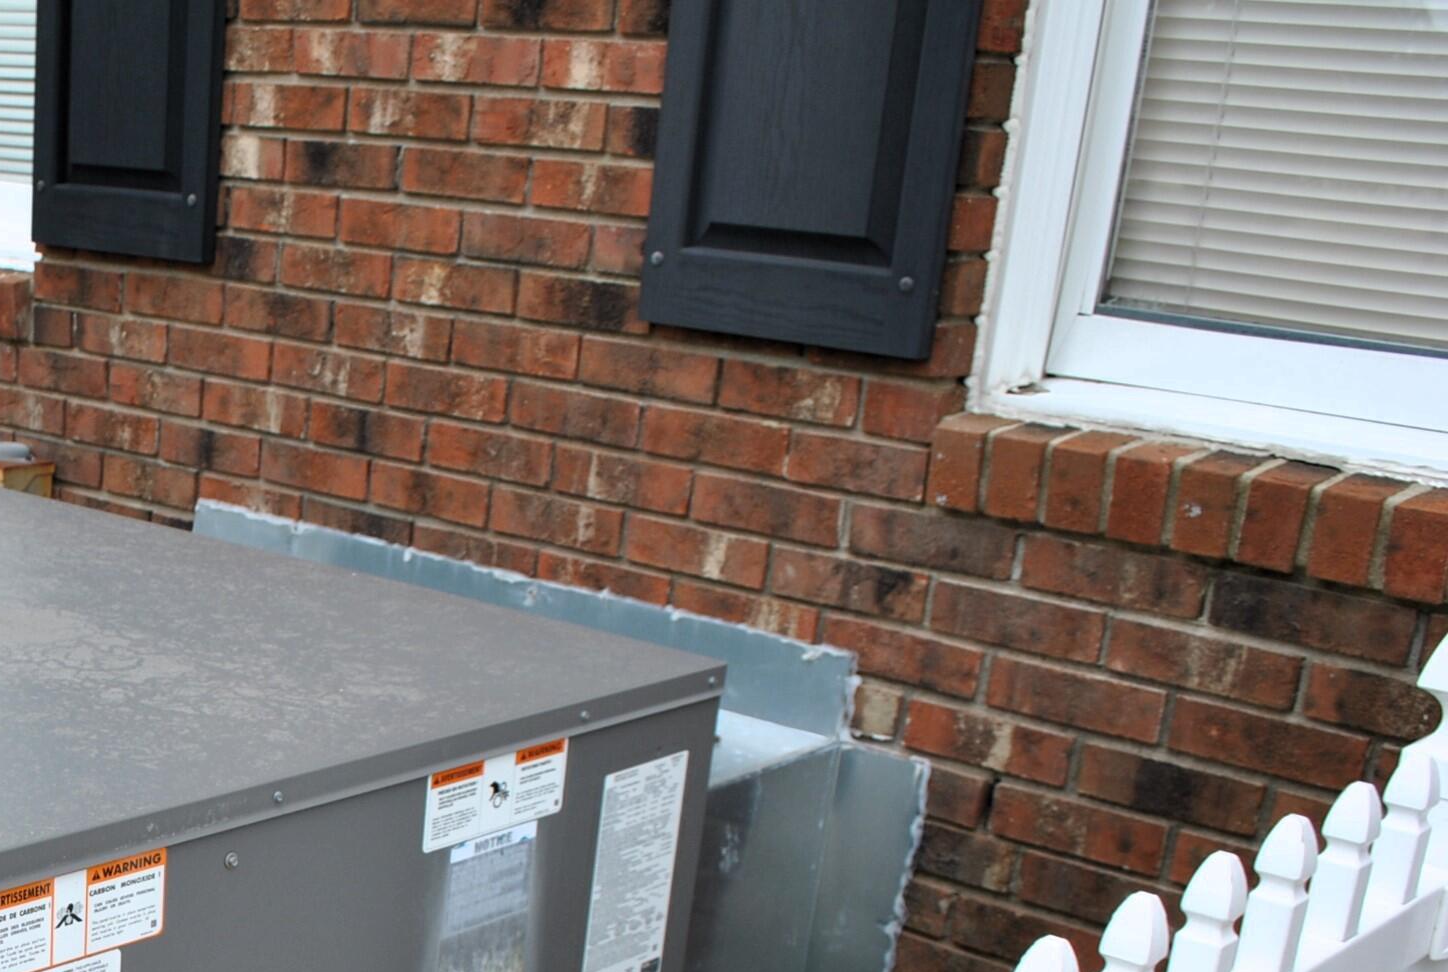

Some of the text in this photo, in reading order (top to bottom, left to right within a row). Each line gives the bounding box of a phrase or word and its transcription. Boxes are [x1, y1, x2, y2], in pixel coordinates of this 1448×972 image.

[102, 853, 162, 878] WARNING
[89, 884, 116, 897] CARBON
[120, 873, 156, 888] MONOXIDE
[9, 911, 17, 919] DE
[19, 905, 47, 916] CARBONE
